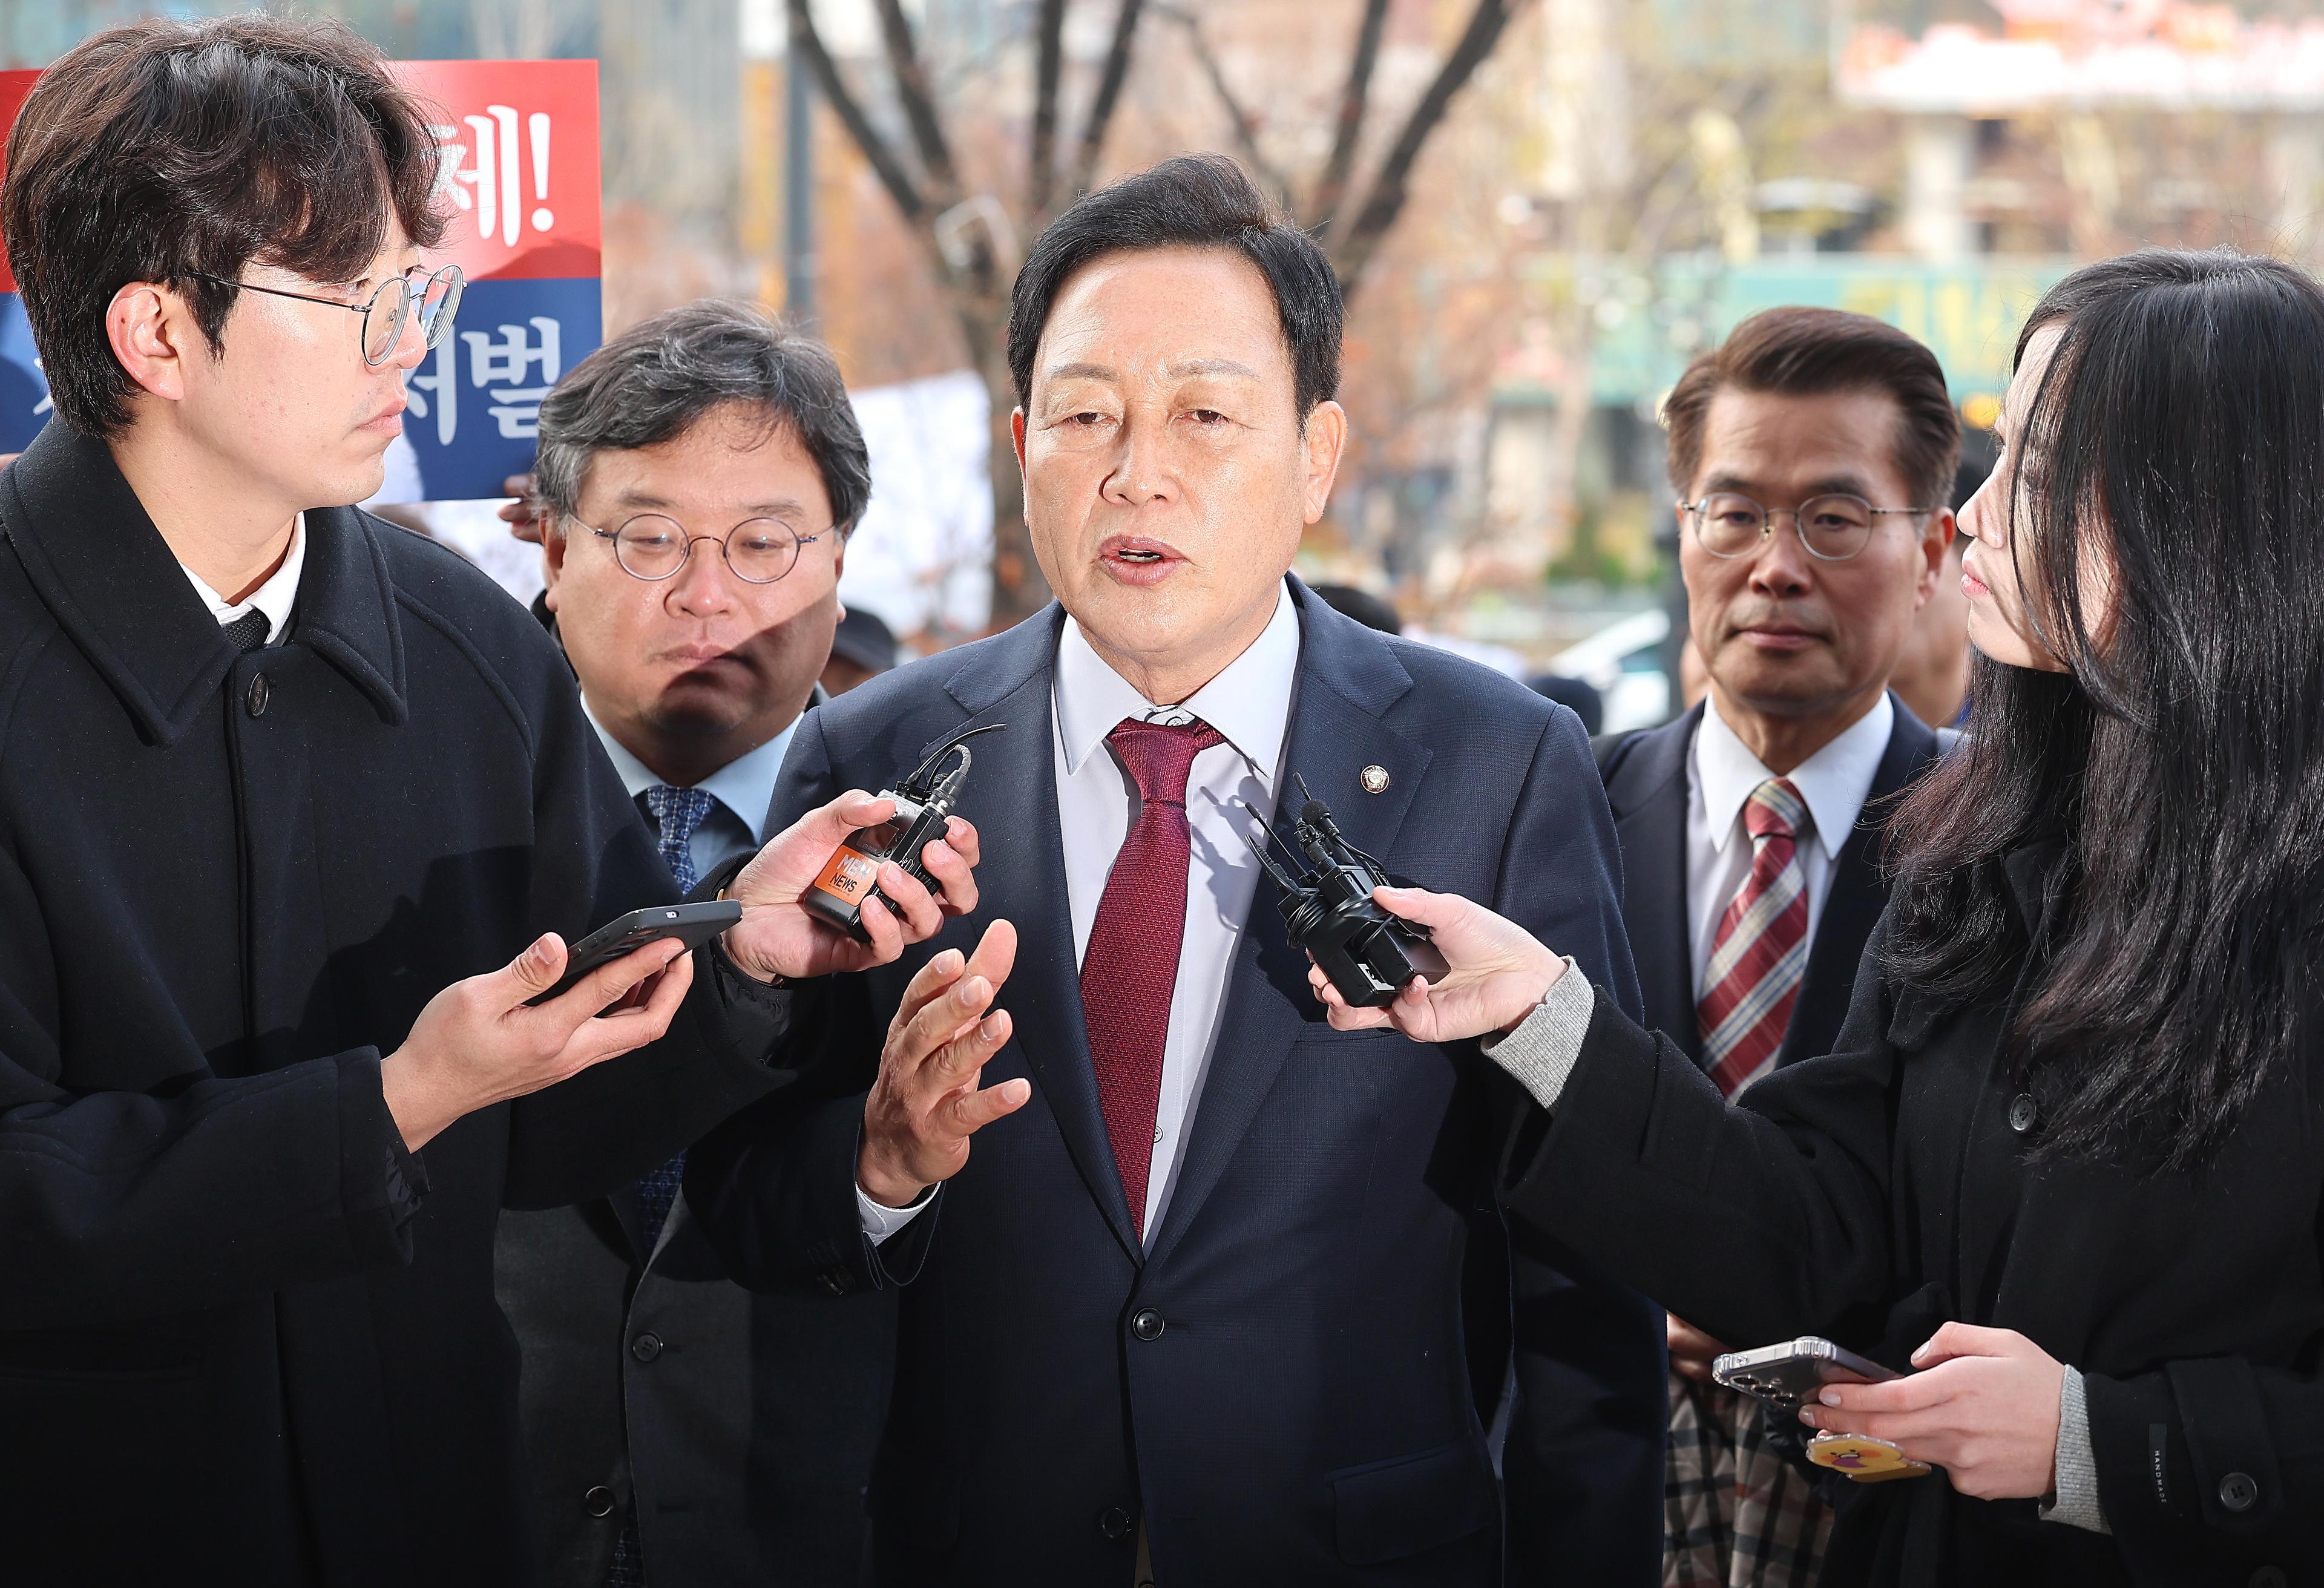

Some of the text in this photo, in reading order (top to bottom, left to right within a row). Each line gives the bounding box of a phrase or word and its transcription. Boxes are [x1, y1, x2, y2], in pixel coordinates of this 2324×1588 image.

[836, 854, 872, 881] MBN
[830, 872, 857, 892] NEWS
[2155, 1450, 2167, 1503] HANDMADE
